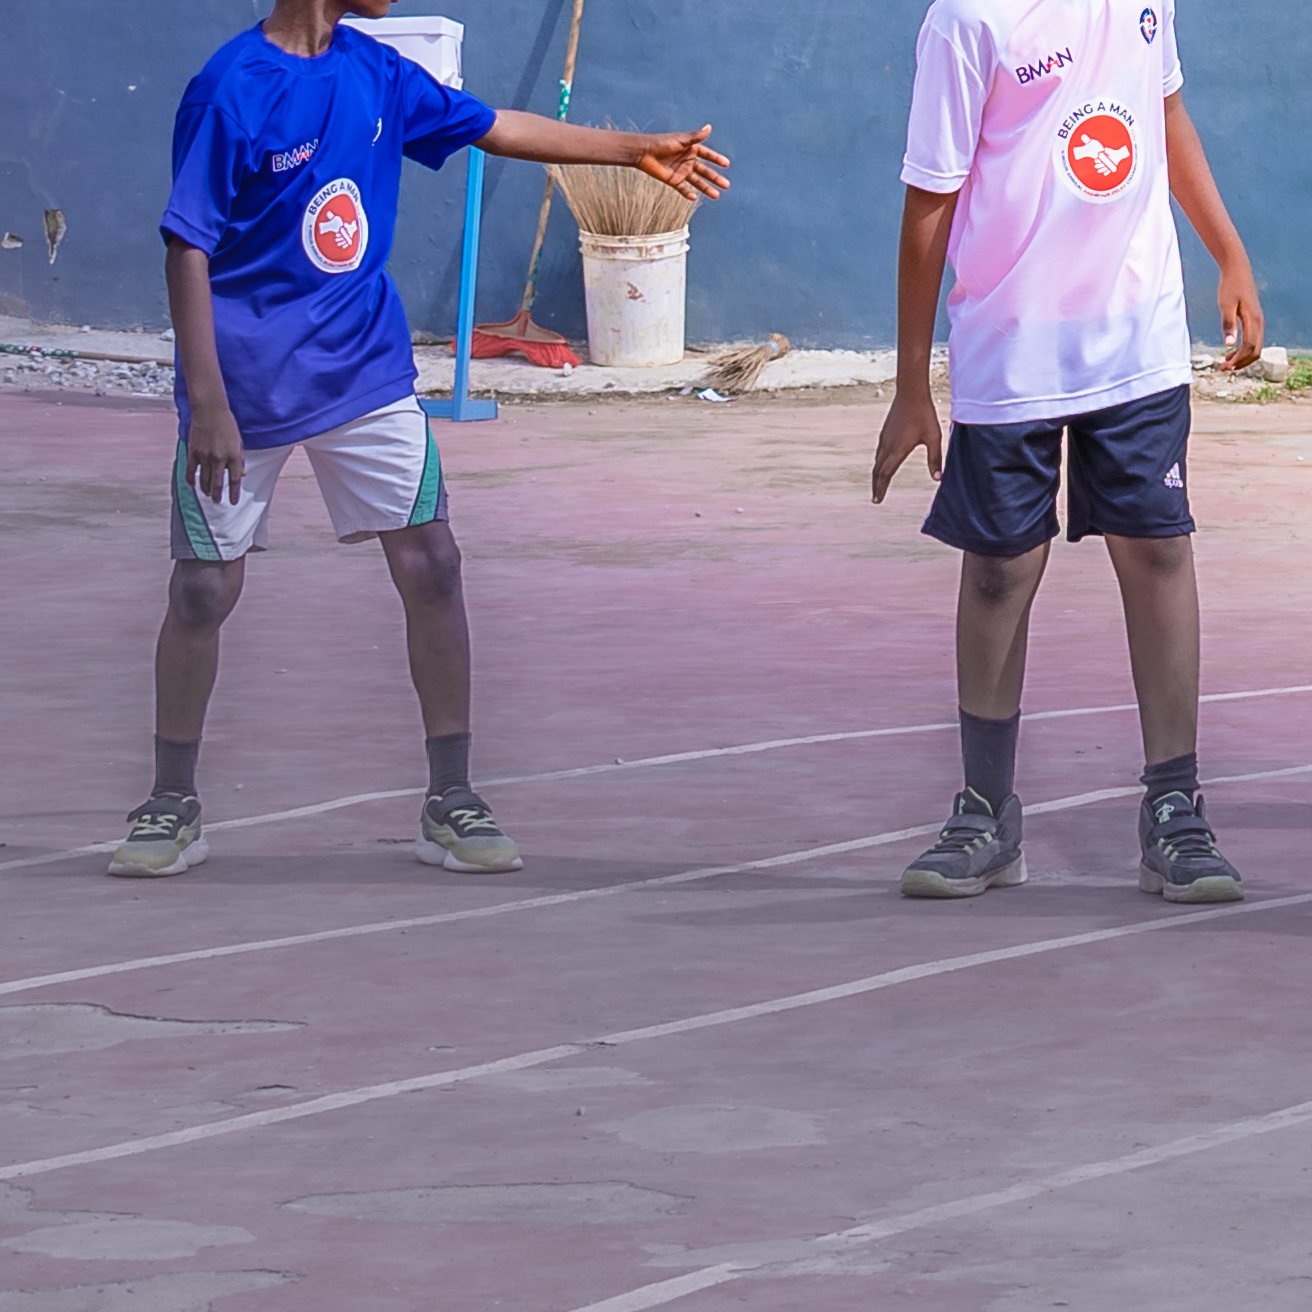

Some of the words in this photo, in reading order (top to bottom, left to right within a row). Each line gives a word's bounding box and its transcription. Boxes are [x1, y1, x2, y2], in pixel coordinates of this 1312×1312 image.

[1015, 47, 1073, 84] BMAN
[1057, 103, 1094, 139] BEING
[1097, 101, 1106, 111] A
[1109, 103, 1135, 127] MAN
[308, 183, 338, 215] BEING
[339, 181, 346, 192] A
